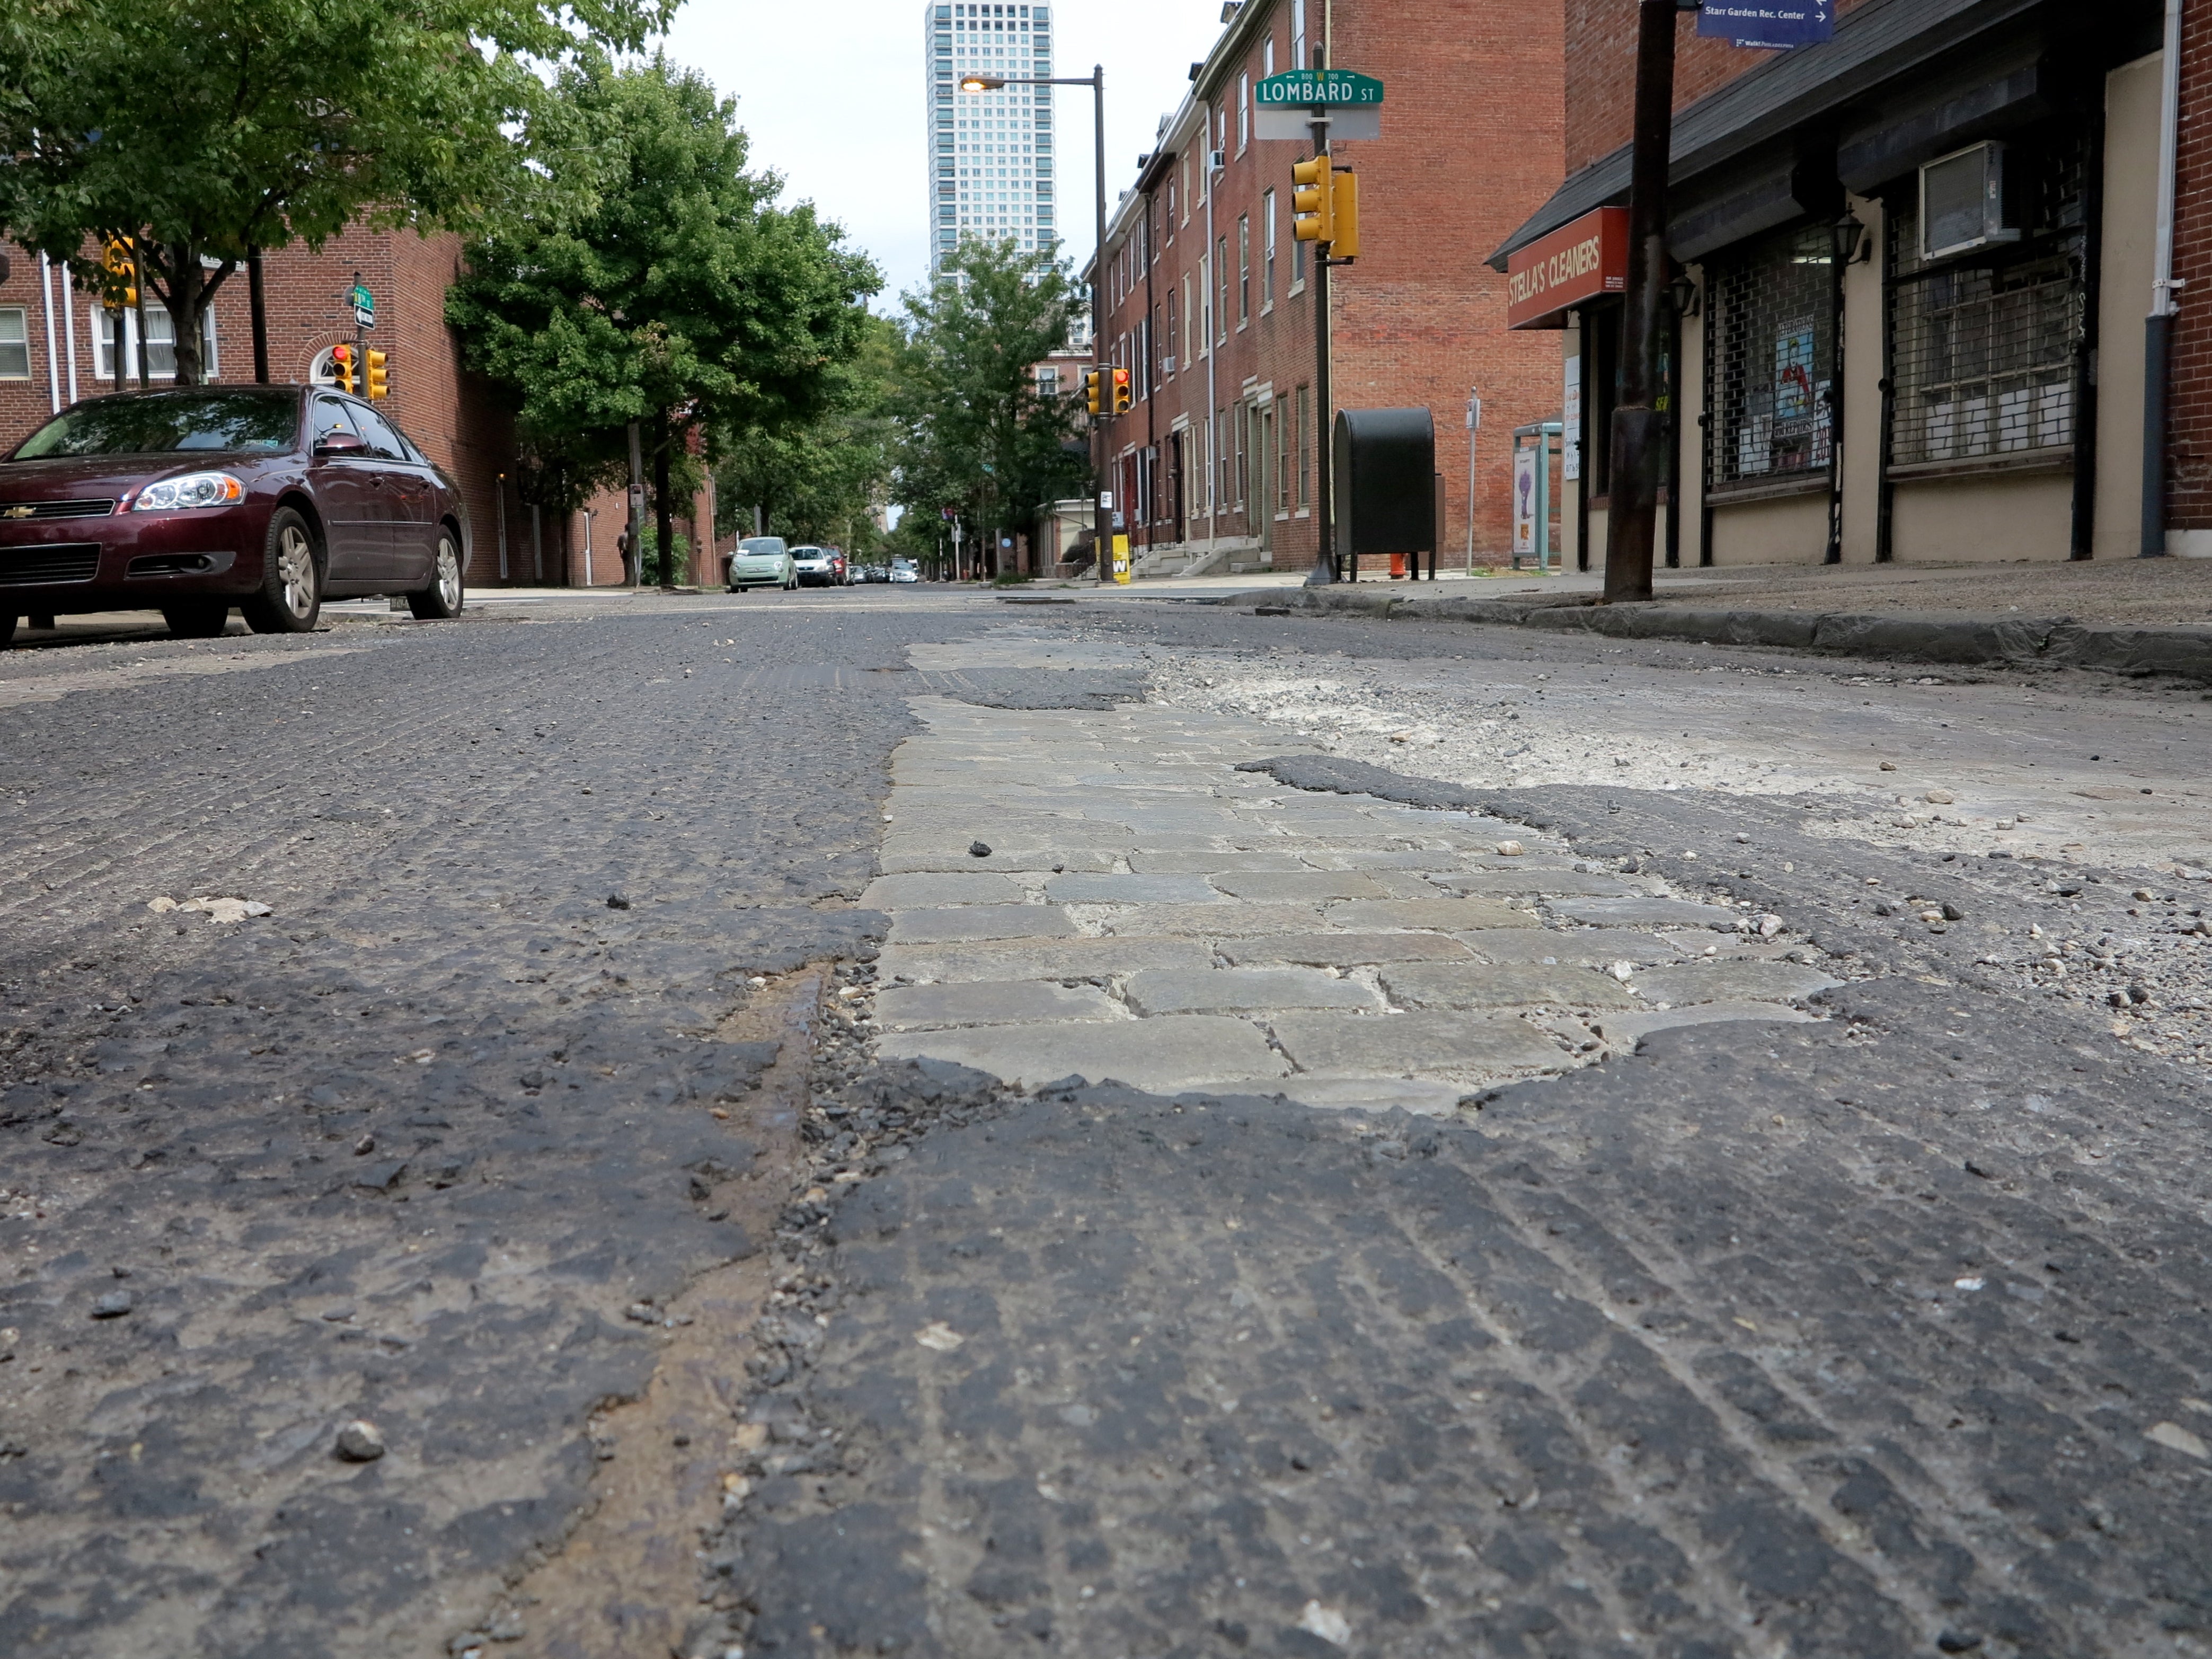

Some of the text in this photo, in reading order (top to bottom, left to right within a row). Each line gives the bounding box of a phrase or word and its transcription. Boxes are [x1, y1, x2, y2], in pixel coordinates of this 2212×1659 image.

[1705, 6, 1805, 20] Starr Garden Rec. Center
[1317, 72, 1324, 81] W
[1263, 83, 1374, 101] LOMBARD ST
[1509, 235, 1600, 307] STELLA'S CLEANERS
